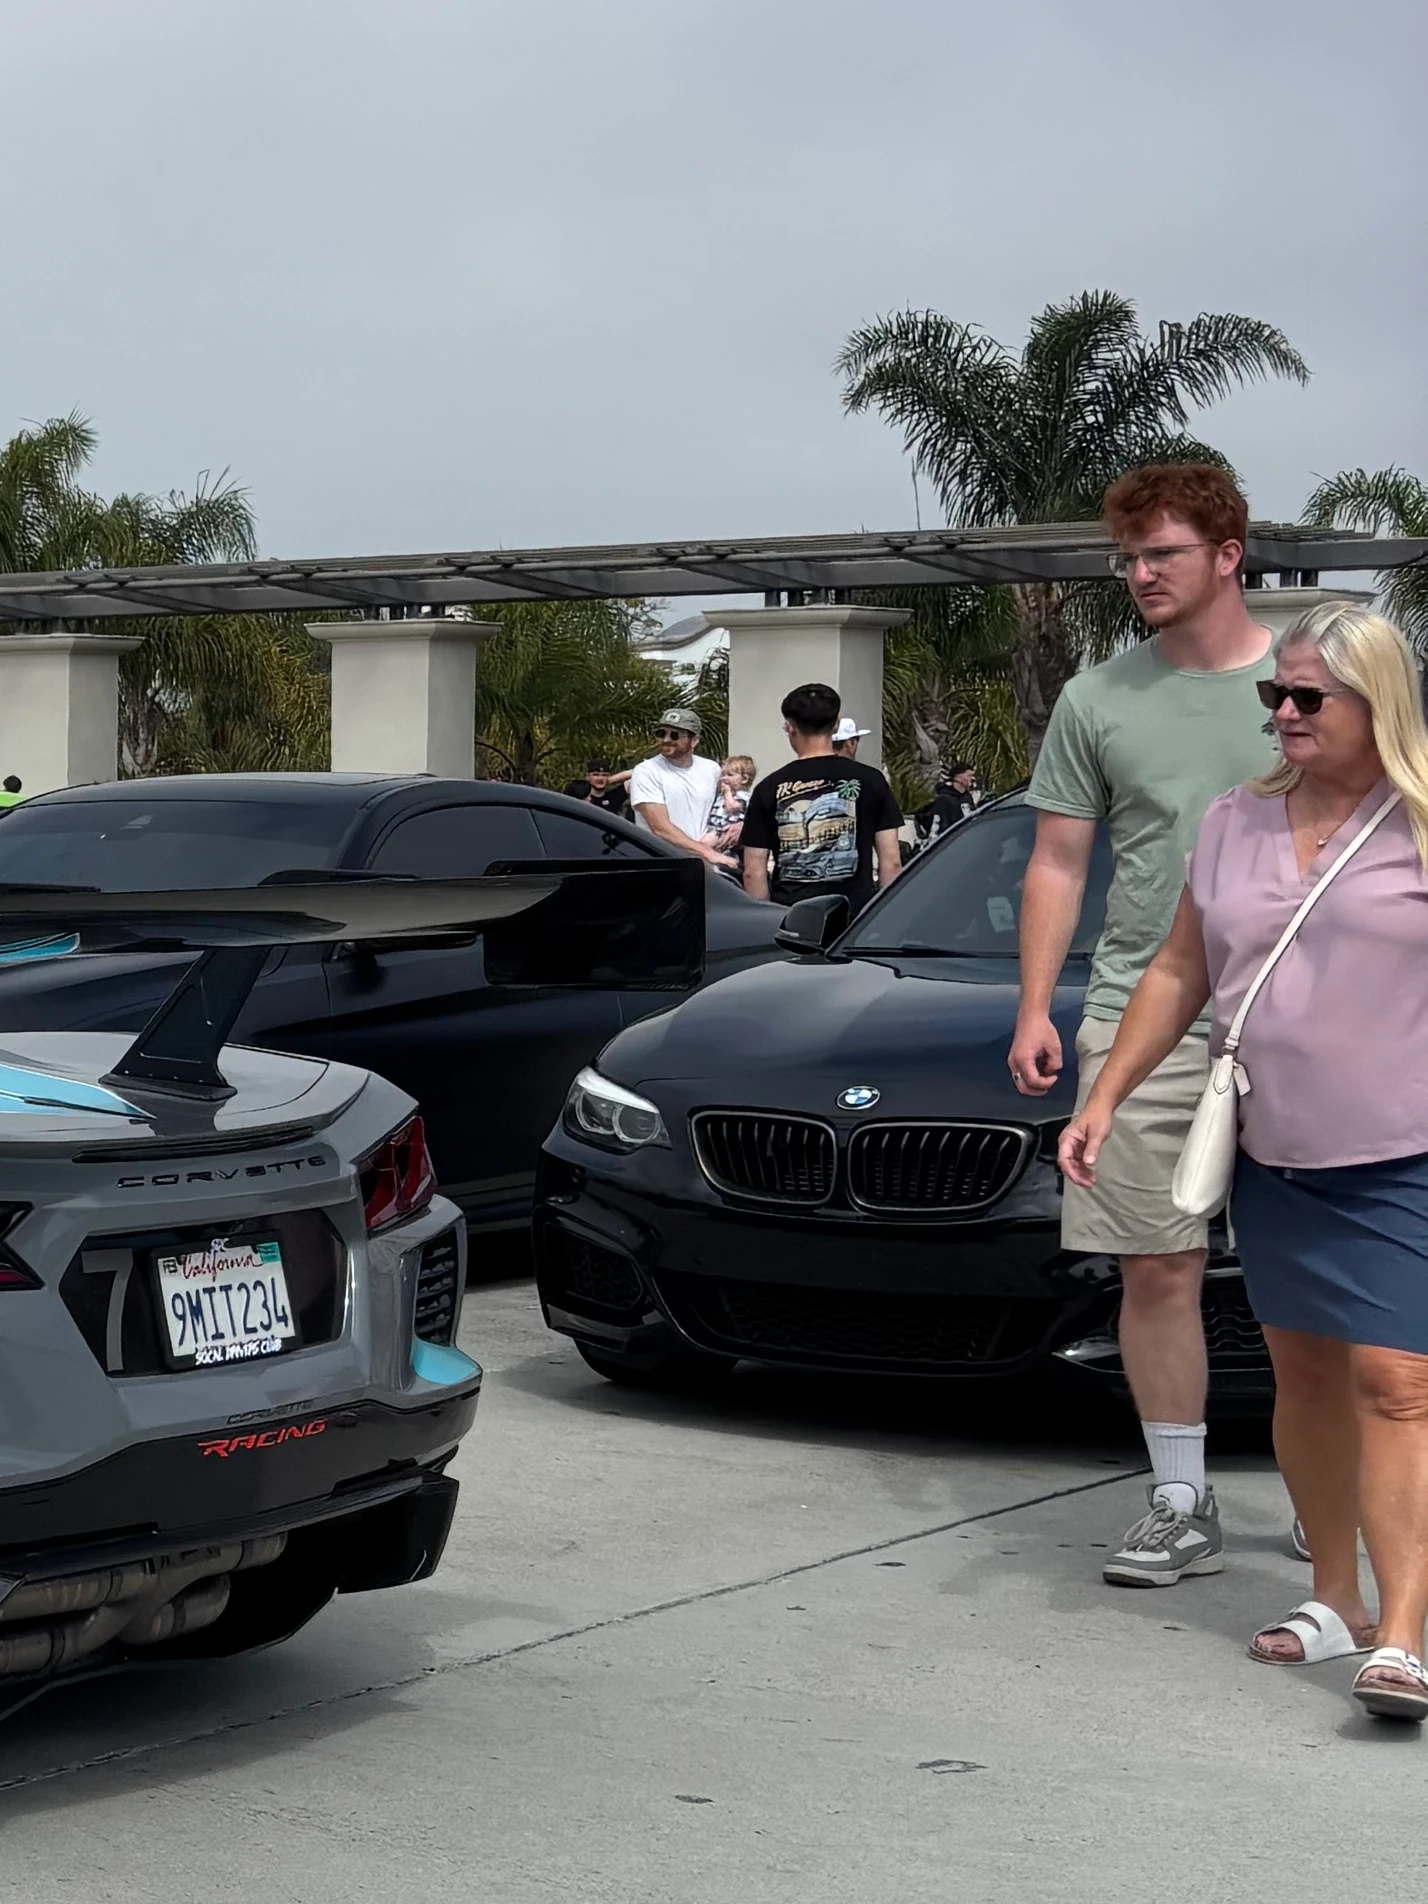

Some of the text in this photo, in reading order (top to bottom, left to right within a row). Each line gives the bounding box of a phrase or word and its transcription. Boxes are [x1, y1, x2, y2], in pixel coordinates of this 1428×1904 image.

[116, 1155, 326, 1188] CORVETTE
[179, 1248, 263, 1282] California
[80, 1247, 135, 1372] 7
[171, 1277, 289, 1348] 9MIT234
[197, 1417, 328, 1459] RACING
